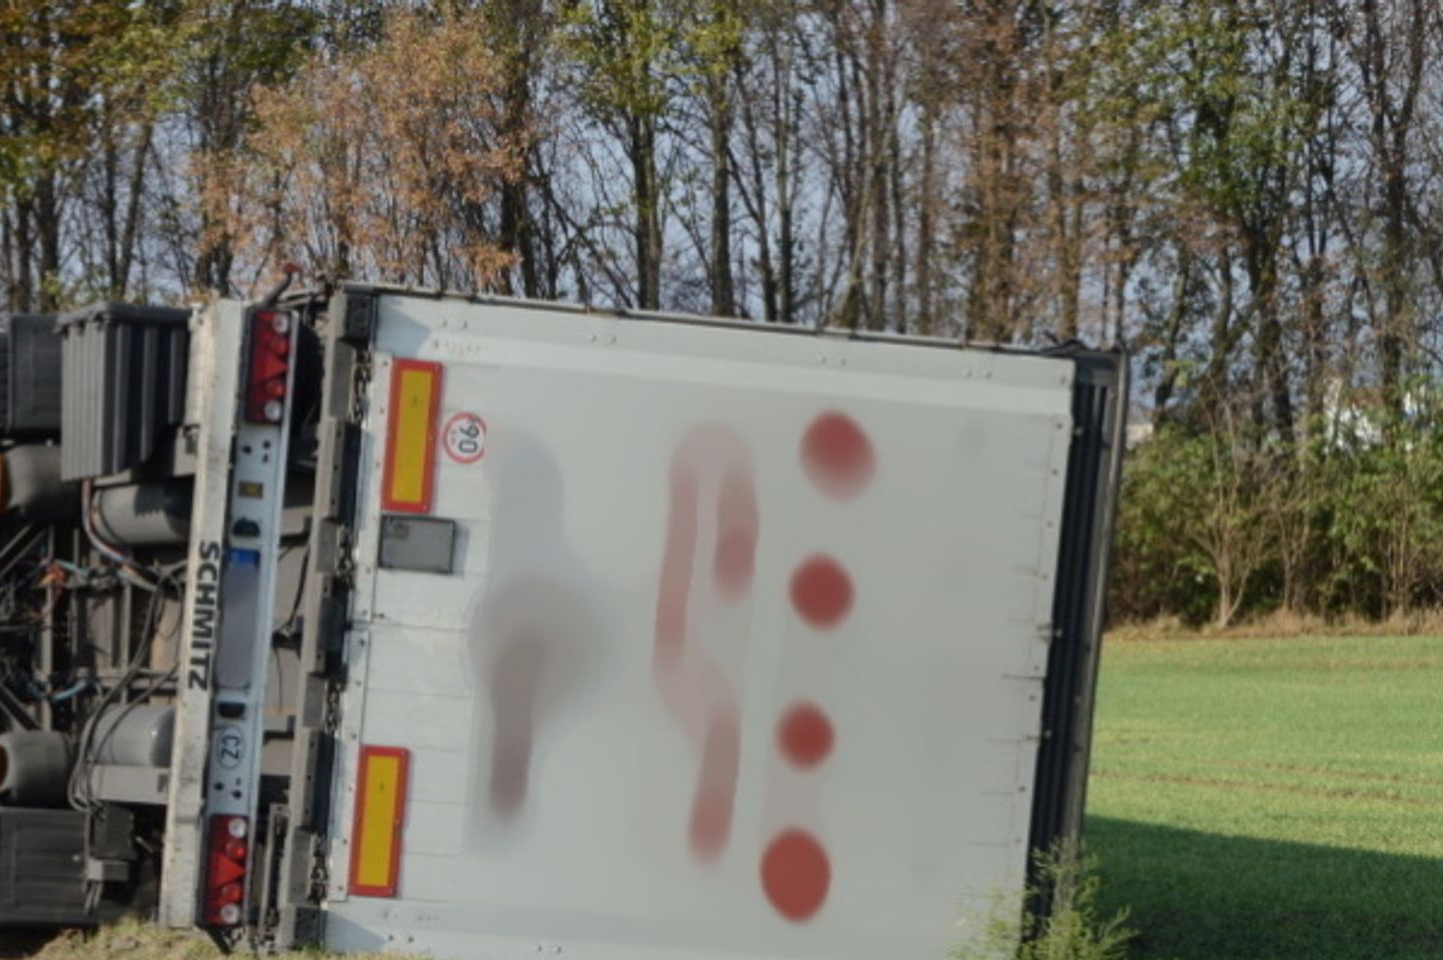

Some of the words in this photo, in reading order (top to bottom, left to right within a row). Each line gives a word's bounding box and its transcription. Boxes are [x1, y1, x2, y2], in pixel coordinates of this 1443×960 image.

[458, 424, 480, 454] 90
[187, 540, 220, 691] SCHMITZ
[221, 734, 241, 760] CZ
